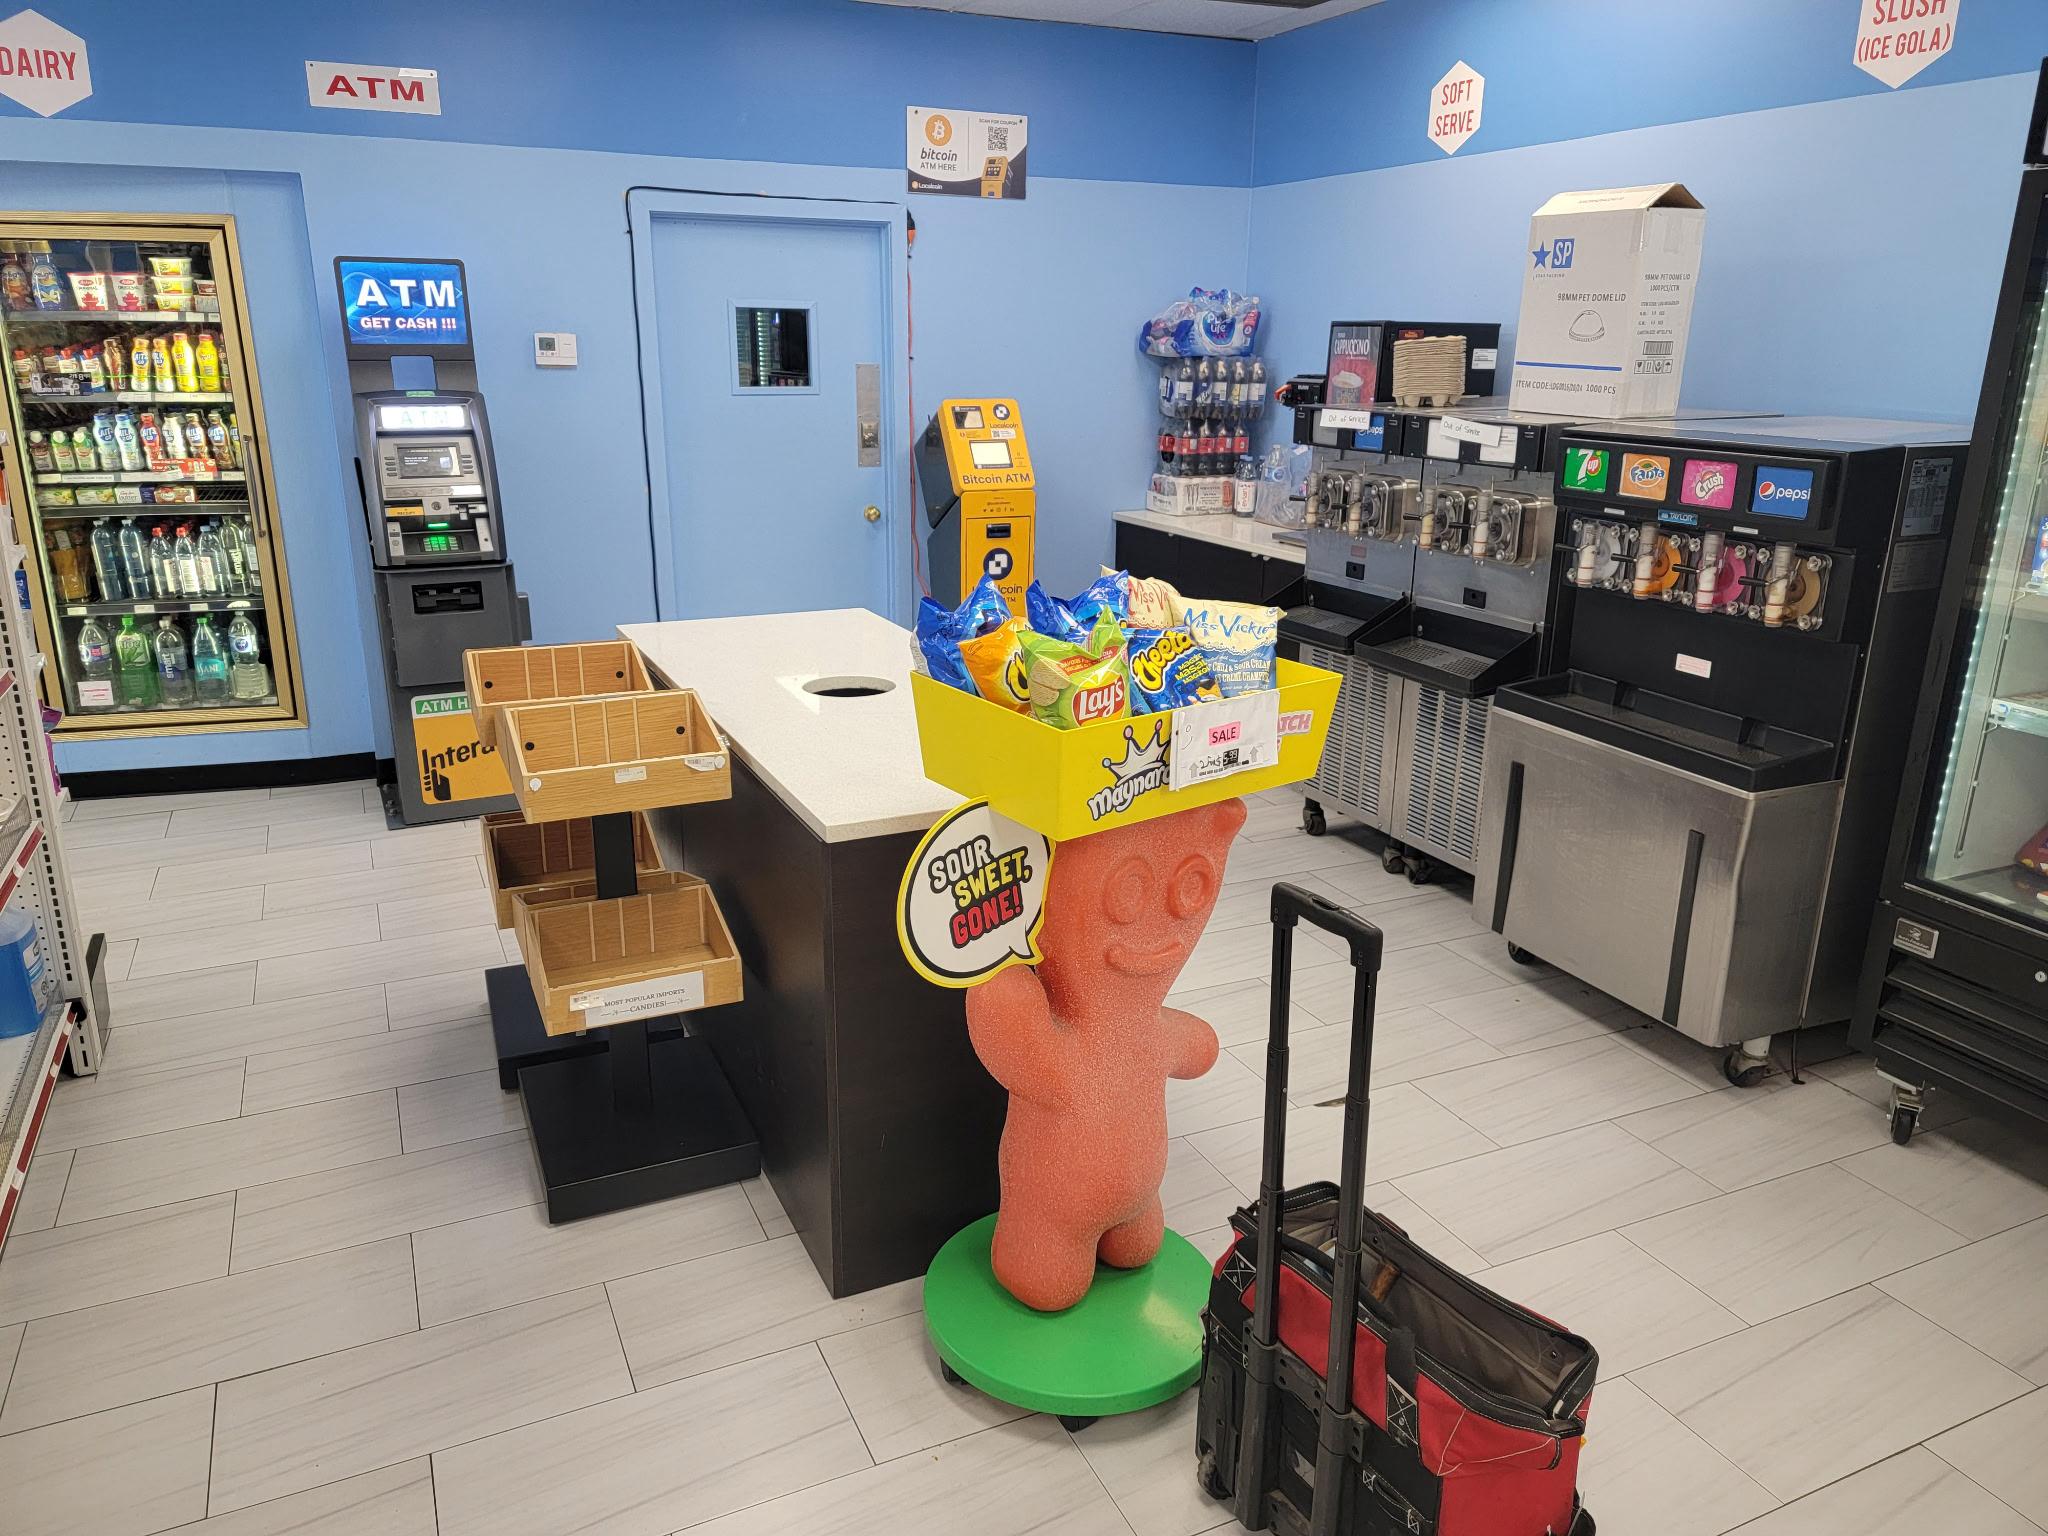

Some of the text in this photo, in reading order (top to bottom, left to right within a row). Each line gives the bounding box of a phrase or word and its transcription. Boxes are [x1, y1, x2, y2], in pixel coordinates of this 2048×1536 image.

[1857, 23, 1951, 63] (ICE GOLA)
[0, 46, 76, 81] DAIRY
[326, 74, 425, 102] ATM
[1441, 78, 1474, 106] SOFT
[1434, 109, 1475, 137] SERVE
[920, 147, 958, 162] bitcoin
[920, 162, 957, 172] ATM HERE
[1553, 240, 1573, 266] SP
[356, 278, 457, 308] ATM
[1557, 293, 1627, 302] 98MM PET DOME LID
[360, 316, 457, 329] GET CASH !!!
[1334, 338, 1370, 357] CAPPUCCINO
[1585, 383, 1603, 394] 1000
[1602, 384, 1617, 395] PCS
[962, 472, 1031, 485] Bitcoin ATM
[1630, 465, 1666, 484] Fanta
[1694, 471, 1725, 499] Crush
[1775, 486, 1811, 502] pepsi
[1183, 606, 1218, 631] Miss
[1132, 630, 1193, 691] Cheeto
[1174, 658, 1208, 681] Masal
[420, 698, 453, 714] ATM
[1079, 680, 1124, 721] Lay's
[1212, 726, 1237, 744] SALE
[421, 739, 497, 776] Intera
[1087, 764, 1170, 821] Maynar
[930, 838, 992, 890] SOUR
[953, 849, 1031, 908] SWEET,
[951, 885, 1021, 946] GONE!
[604, 988, 686, 1008] MOST POPULAR IMPORTS
